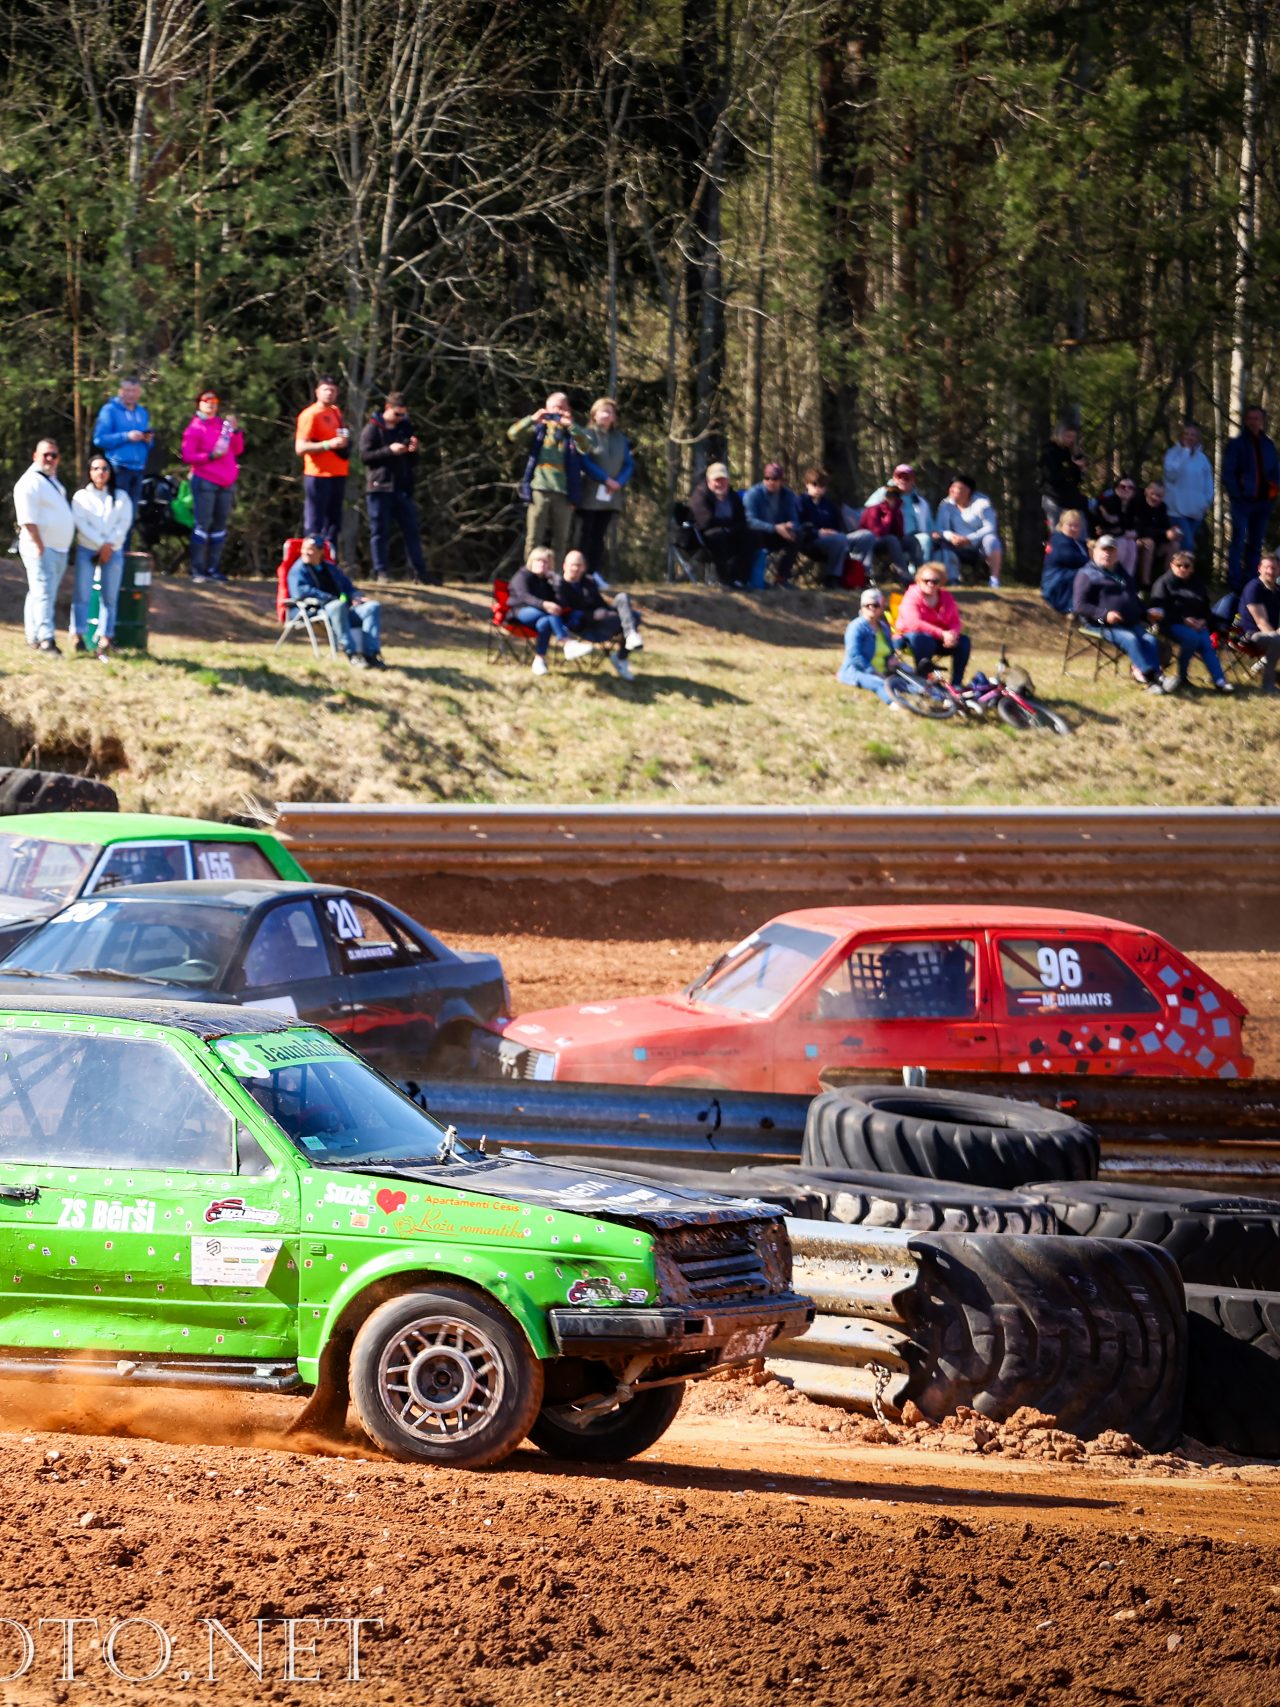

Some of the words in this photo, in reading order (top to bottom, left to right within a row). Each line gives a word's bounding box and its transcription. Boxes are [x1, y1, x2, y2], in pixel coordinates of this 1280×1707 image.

[199, 851, 236, 880] 155
[51, 901, 108, 924] 20
[326, 899, 363, 939] 20
[1036, 946, 1082, 988] 96
[216, 1039, 271, 1079] 8
[57, 1197, 87, 1229] ZS
[91, 1198, 156, 1233] Bērši
[424, 1195, 490, 1210] Apartamenti
[459, 1219, 525, 1239] romantika
